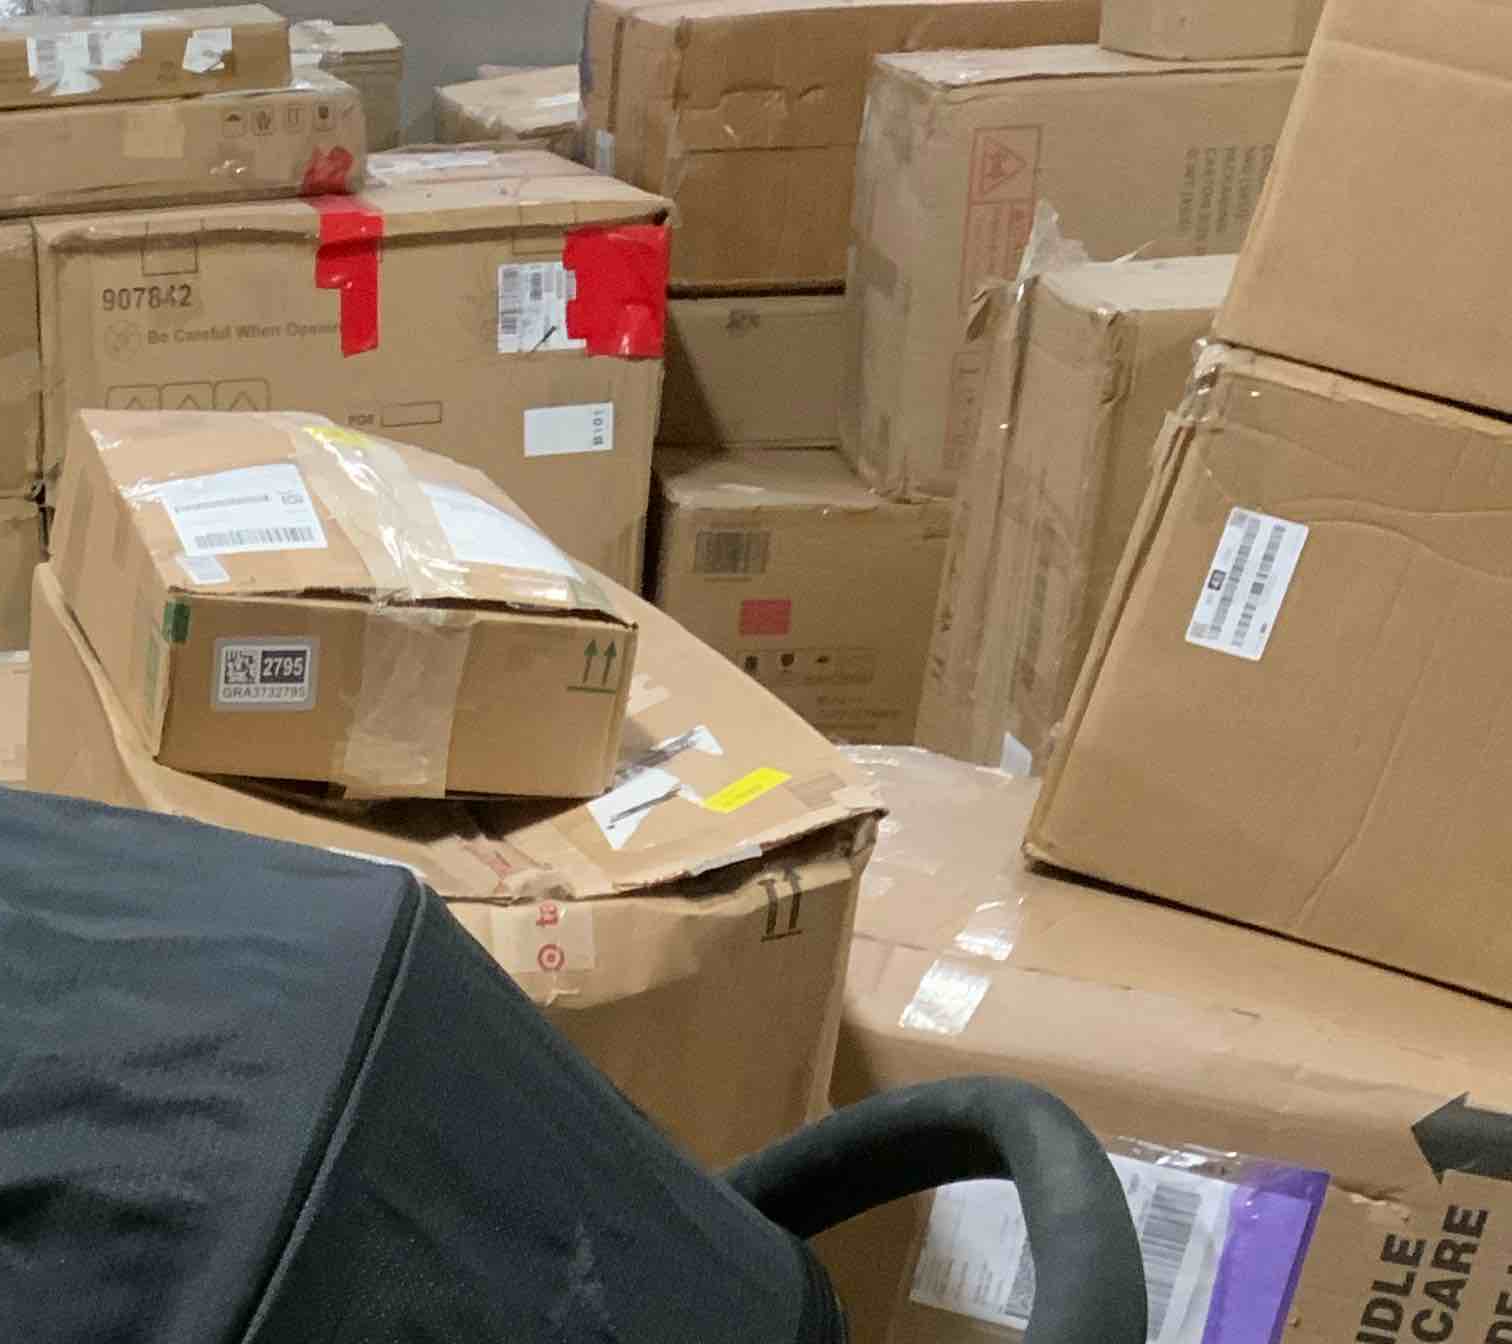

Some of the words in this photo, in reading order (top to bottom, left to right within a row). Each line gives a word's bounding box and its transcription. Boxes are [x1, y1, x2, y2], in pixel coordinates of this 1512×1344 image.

[101, 284, 192, 312] 907842
[262, 657, 304, 677] 2795
[1412, 1204, 1490, 1343] CARE
